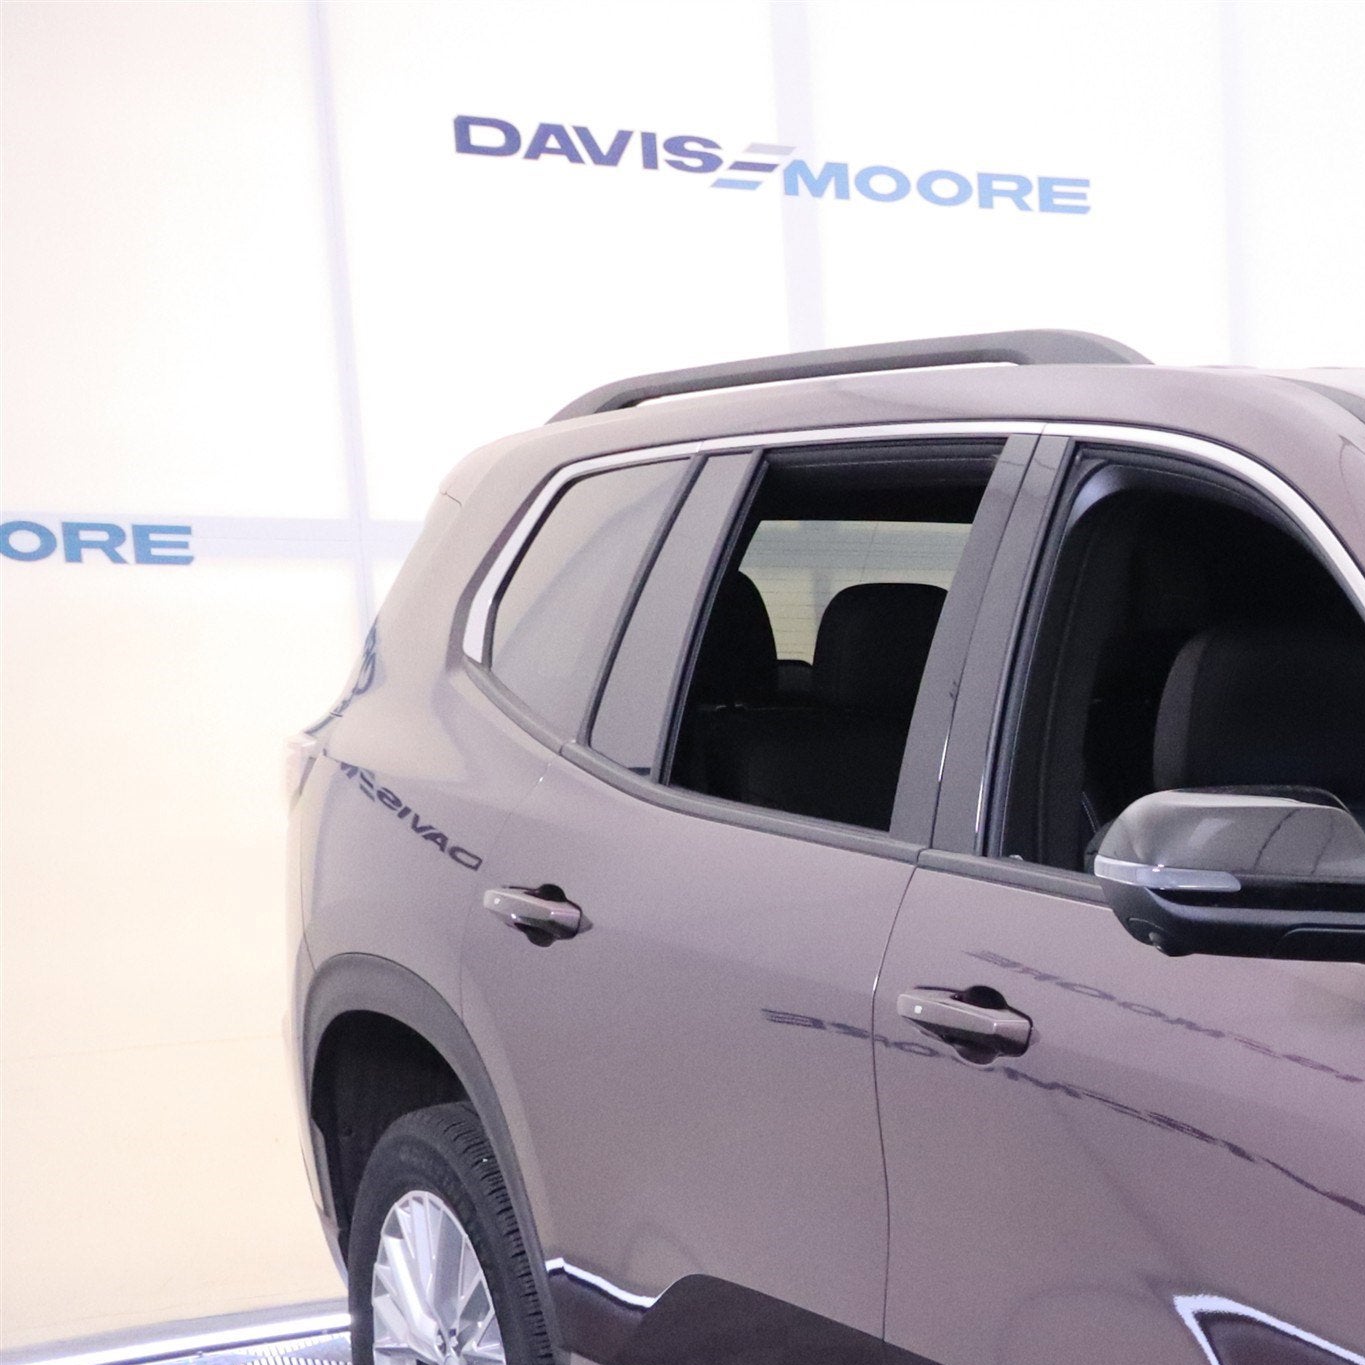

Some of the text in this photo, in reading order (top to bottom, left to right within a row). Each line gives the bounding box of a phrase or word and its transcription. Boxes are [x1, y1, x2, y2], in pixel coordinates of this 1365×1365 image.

[453, 114, 1091, 215] DAVIS MOORE
[0, 521, 194, 565] ORE
